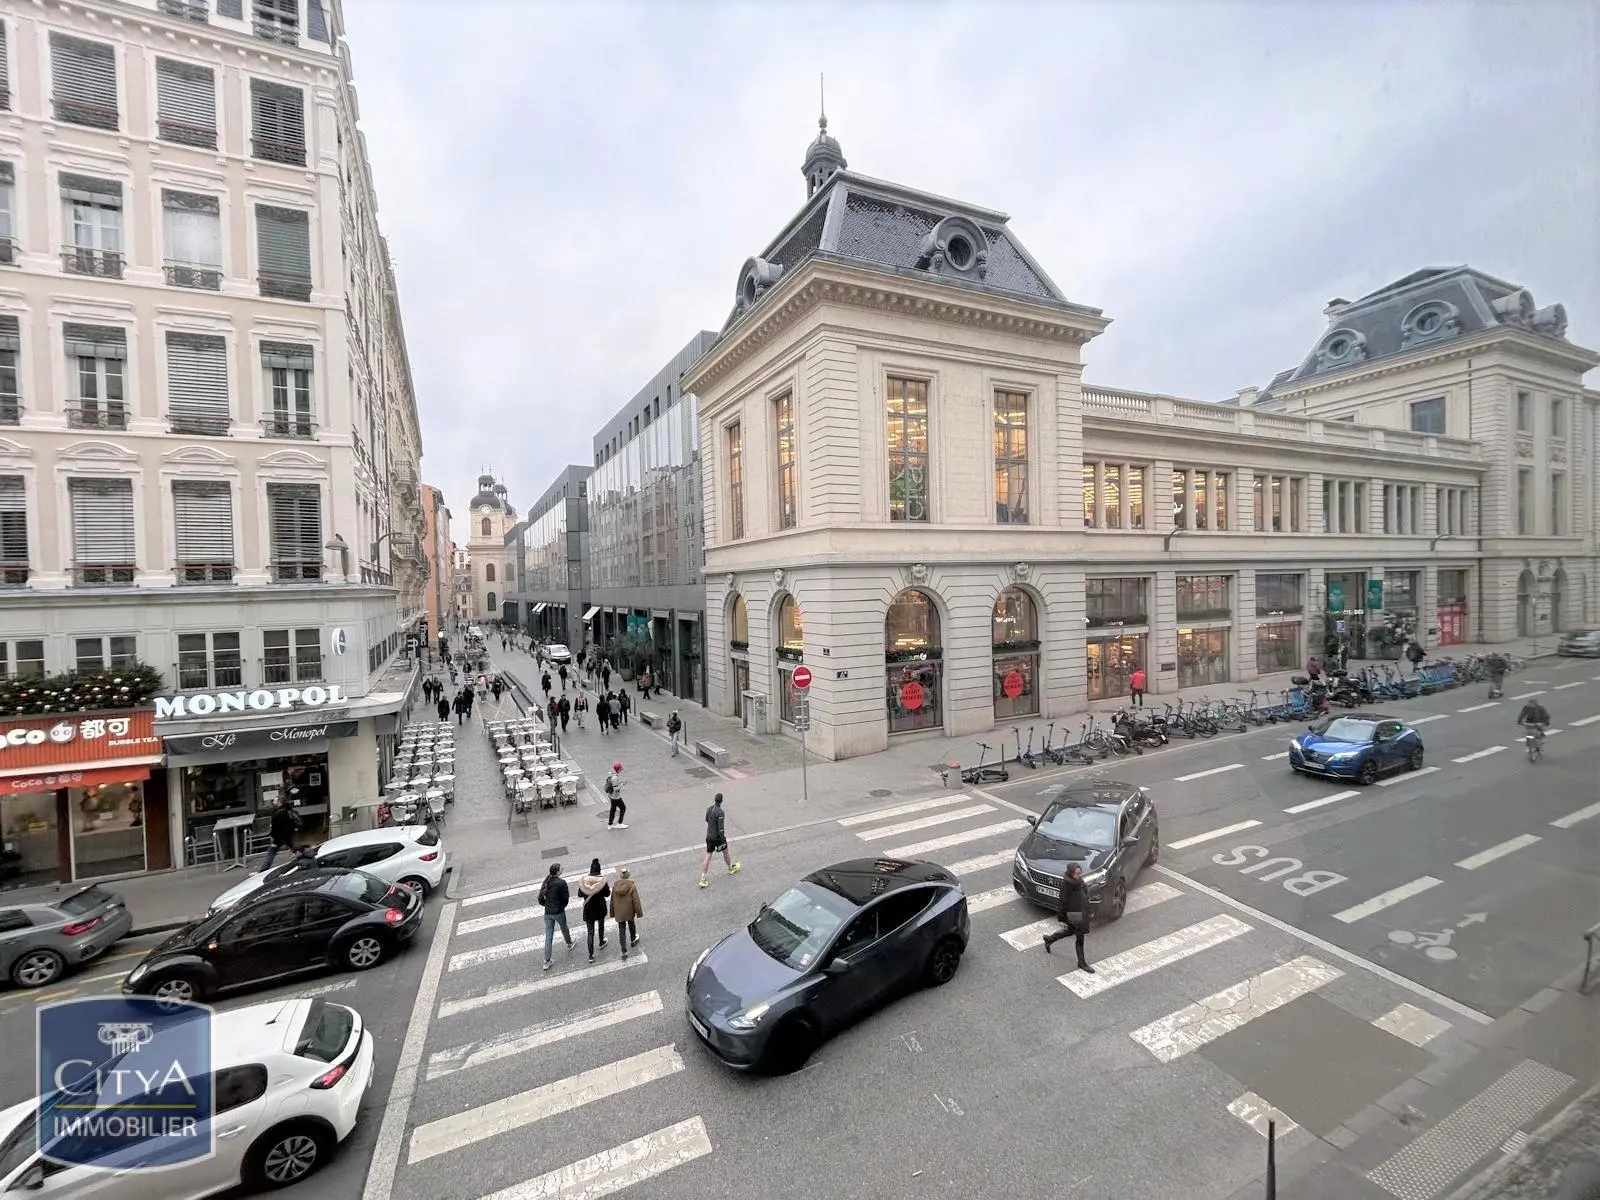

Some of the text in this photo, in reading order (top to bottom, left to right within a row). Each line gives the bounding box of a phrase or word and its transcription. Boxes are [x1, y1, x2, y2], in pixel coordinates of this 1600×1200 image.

[420, 623, 428, 646] fnac
[153, 685, 348, 719] MONOPOL
[80, 717, 131, 739] 都可
[270, 725, 328, 741] Monopol
[108, 738, 141, 746] BUBBLE
[11, 778, 43, 788] CoCo
[1211, 844, 1349, 897] BUS
